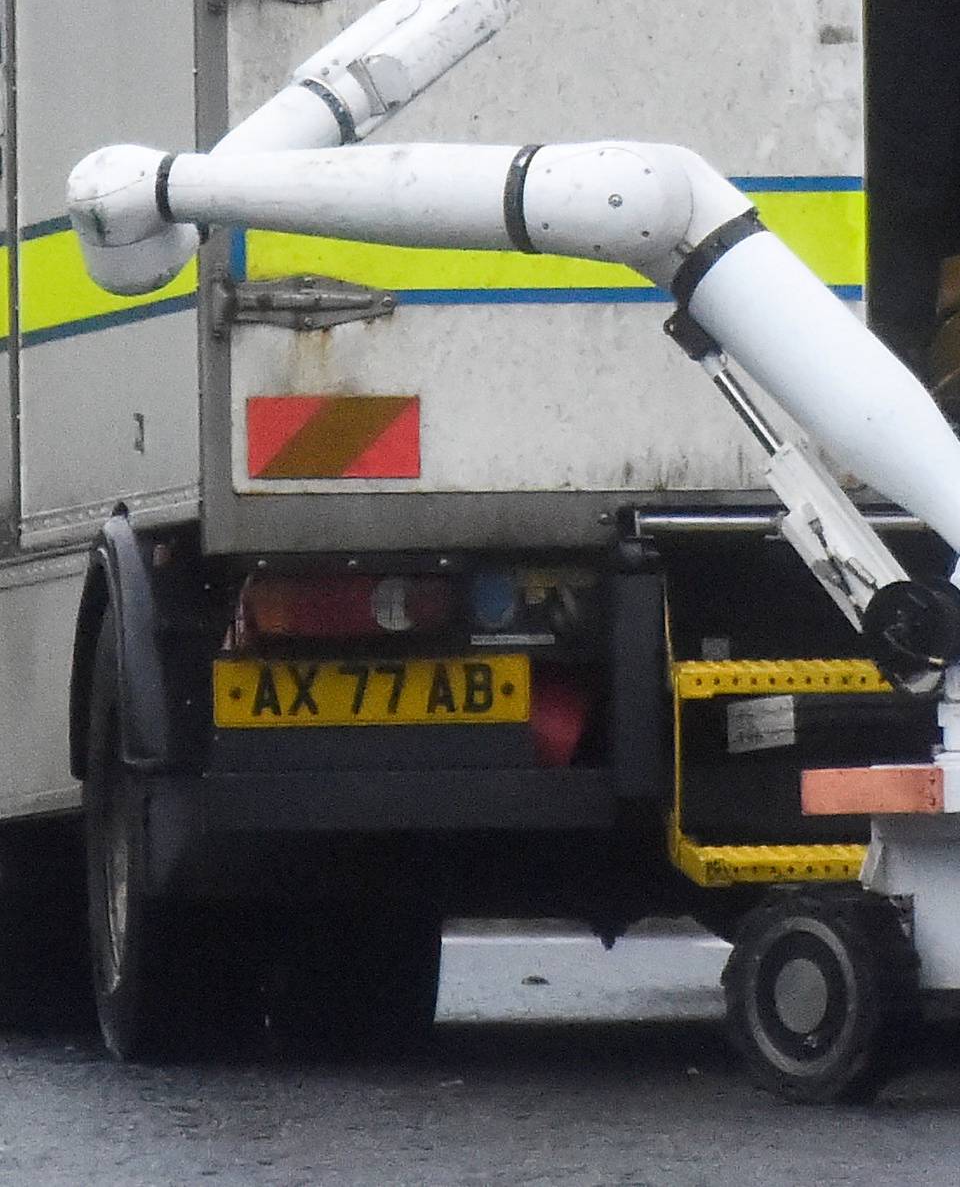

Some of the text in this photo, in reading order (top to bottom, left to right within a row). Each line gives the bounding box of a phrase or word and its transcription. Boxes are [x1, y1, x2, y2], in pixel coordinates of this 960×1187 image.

[252, 662, 494, 716] AX 77 AB
